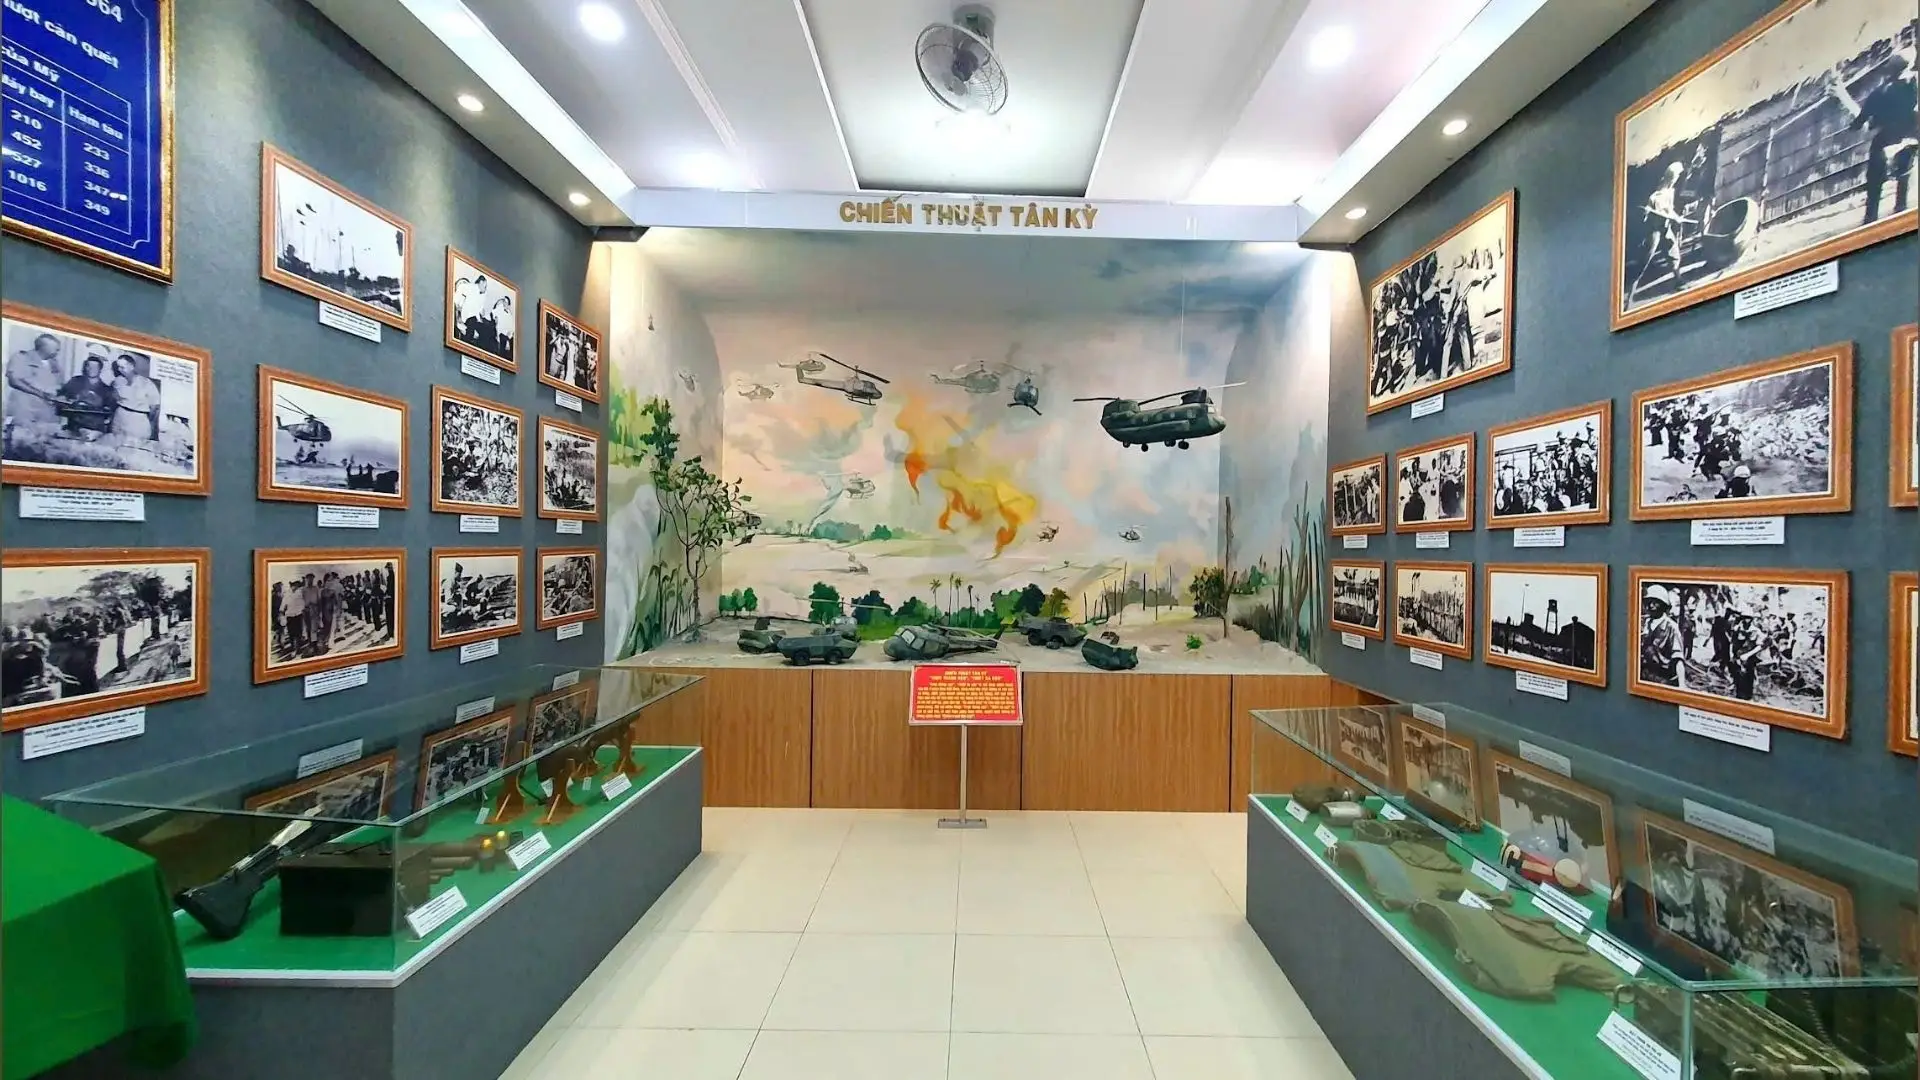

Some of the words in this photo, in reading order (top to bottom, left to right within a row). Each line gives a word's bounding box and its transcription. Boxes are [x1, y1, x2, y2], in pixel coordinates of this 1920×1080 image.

[44, 20, 78, 45] càn
[81, 41, 119, 69] quét
[33, 60, 60, 83] Mỹ
[29, 87, 55, 109] bay
[10, 109, 42, 130] 210
[10, 131, 43, 151] 452
[11, 151, 42, 169] 527
[83, 142, 110, 161] 233
[83, 161, 110, 179] 336
[8, 169, 48, 192] 1016
[84, 180, 110, 197] 347
[83, 199, 111, 217] 349
[839, 196, 913, 225] CHIẾN
[921, 199, 1003, 233] THUẬT
[1009, 201, 1059, 228] TÂN
[1064, 202, 1099, 230] KỲ
